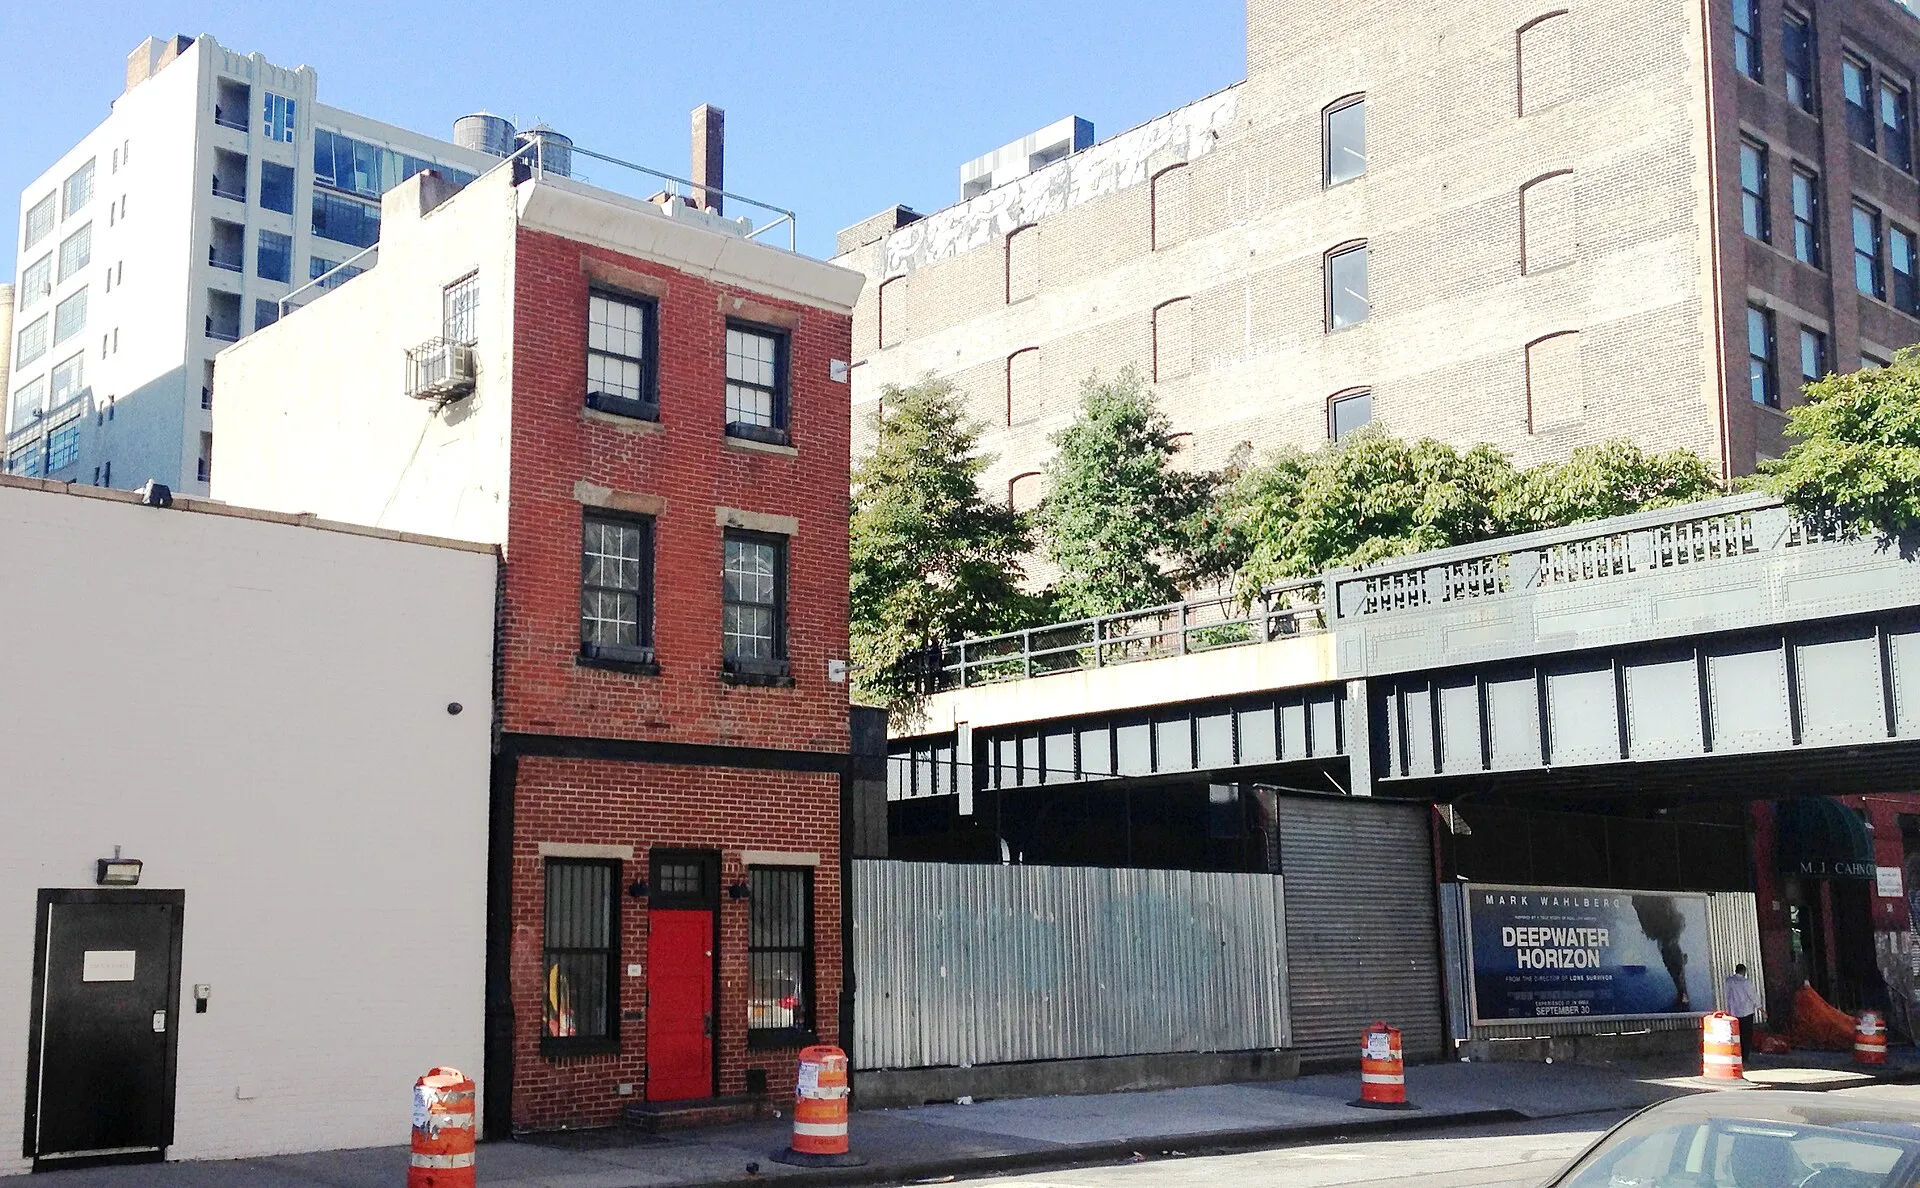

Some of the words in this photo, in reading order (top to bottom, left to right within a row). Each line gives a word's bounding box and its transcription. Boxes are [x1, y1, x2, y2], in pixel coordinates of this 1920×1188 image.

[1485, 895, 1528, 905] MARK
[1540, 896, 1620, 908] WAHLBERG
[1502, 926, 1610, 947] DEEPWATER
[1517, 948, 1600, 969] HORIZON
[1535, 1006, 1579, 1016] SEPTEMBER
[1581, 1005, 1590, 1014] 30
